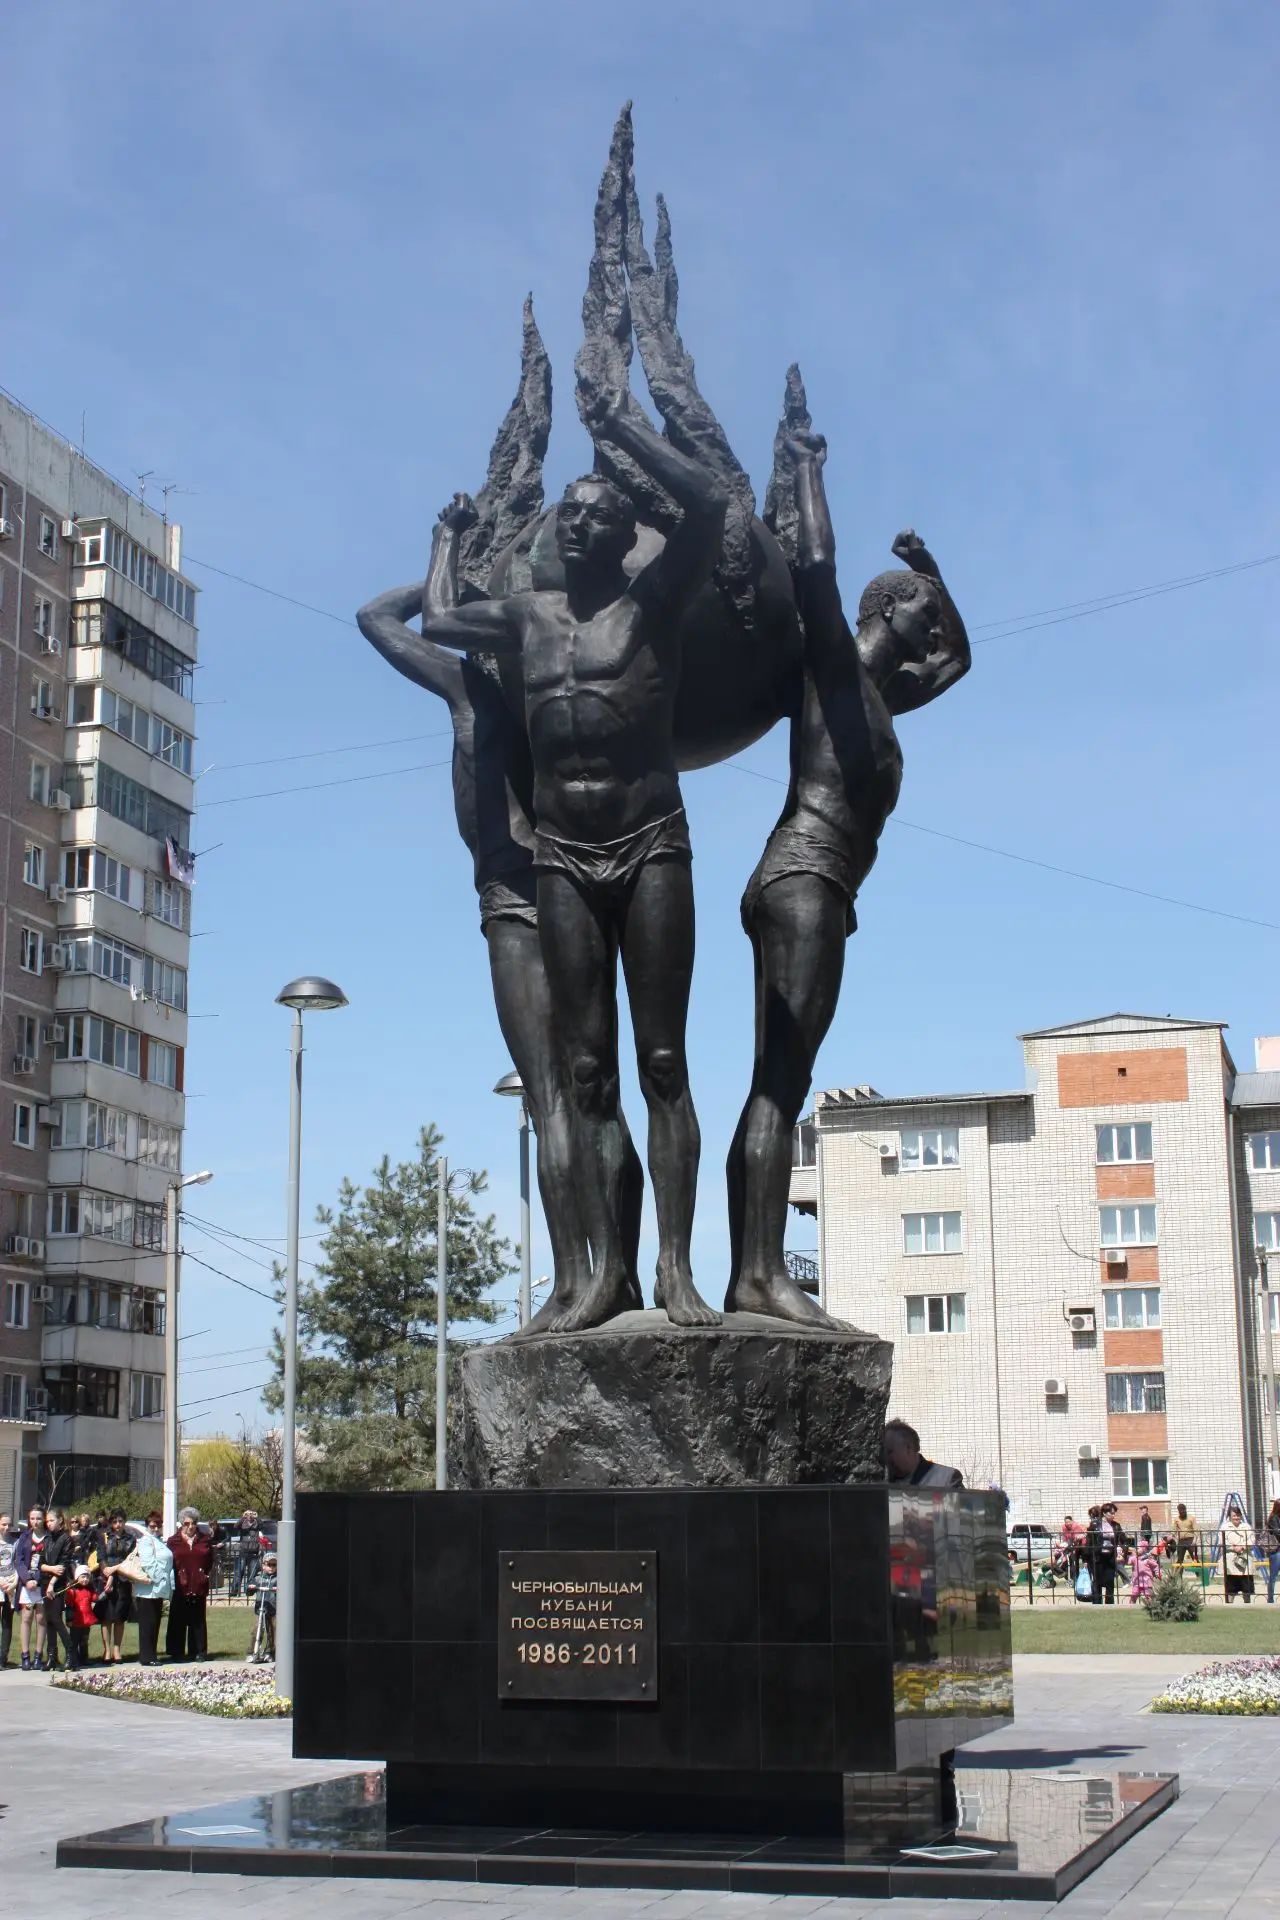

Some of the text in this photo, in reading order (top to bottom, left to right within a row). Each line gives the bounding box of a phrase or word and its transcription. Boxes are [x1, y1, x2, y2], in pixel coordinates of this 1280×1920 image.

[511, 1581, 643, 1595] ЧЕРНОБЫЛЬЦАМ
[541, 1599, 613, 1611] КУБАНИ
[511, 1617, 643, 1631] ПОСВЯЩАЕТСЯ
[517, 1643, 637, 1664] 1986-2011
